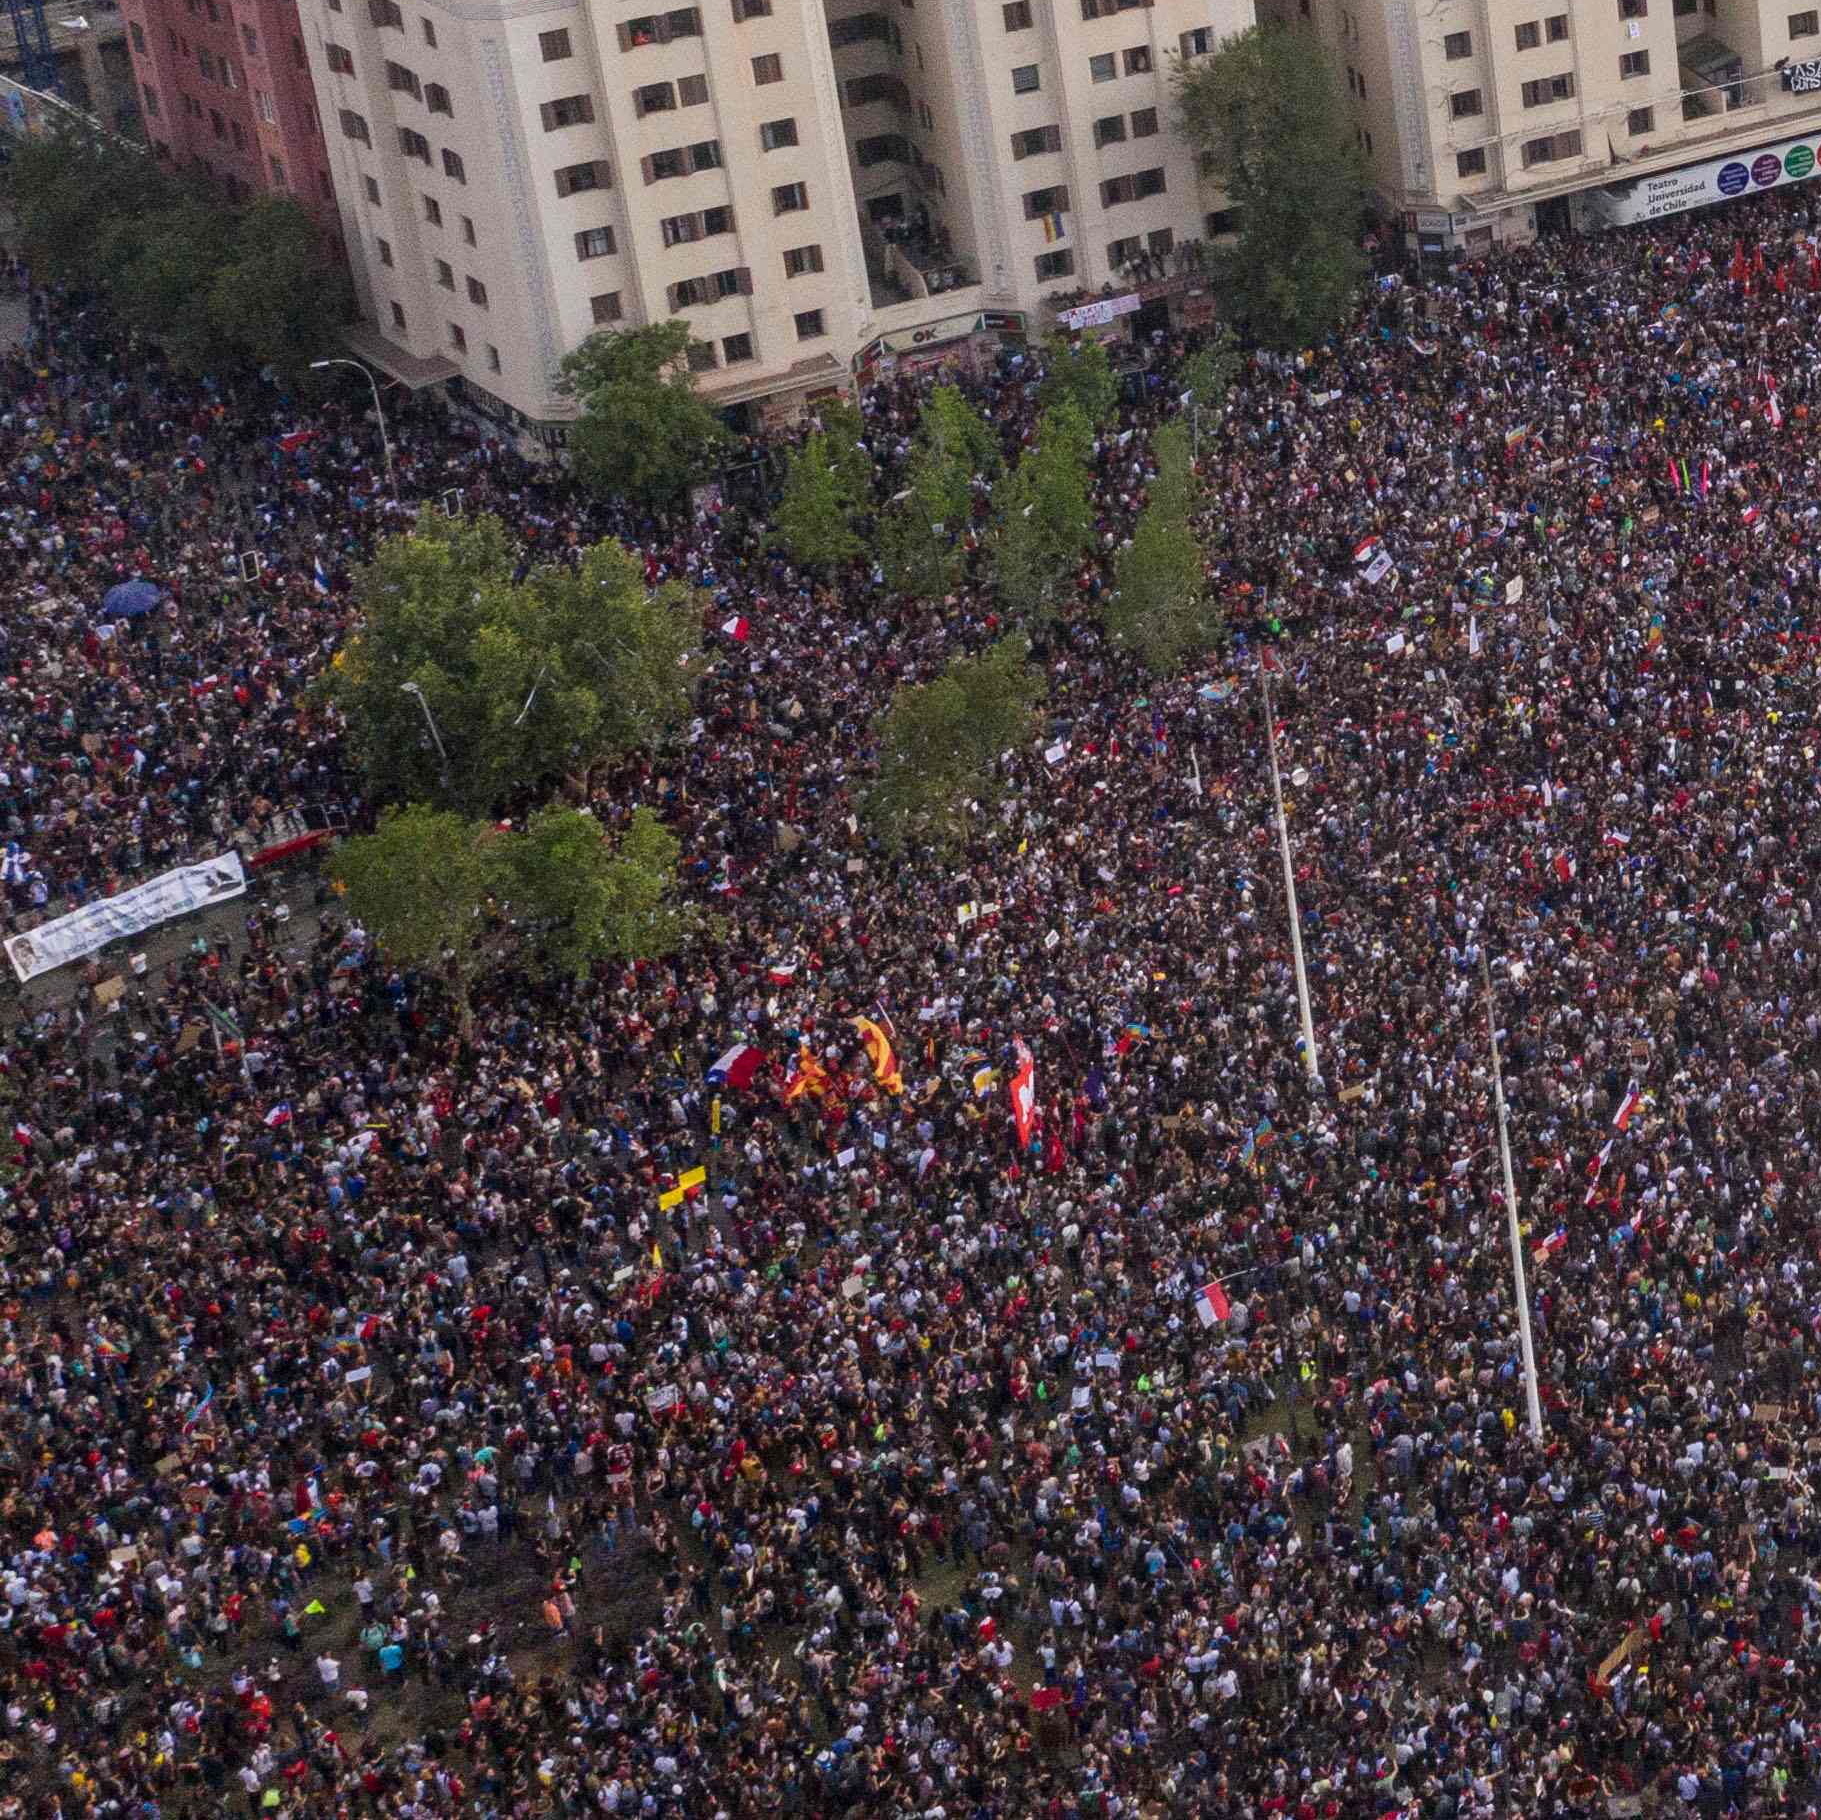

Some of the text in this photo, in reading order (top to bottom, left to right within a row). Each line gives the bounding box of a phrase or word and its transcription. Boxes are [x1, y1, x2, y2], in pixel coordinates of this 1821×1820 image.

[1647, 179, 1678, 191] Teatro
[1647, 181, 1706, 205] Universidad
[1649, 203, 1661, 216] de
[1663, 200, 1687, 213] Chile
[912, 327, 939, 343] OK
